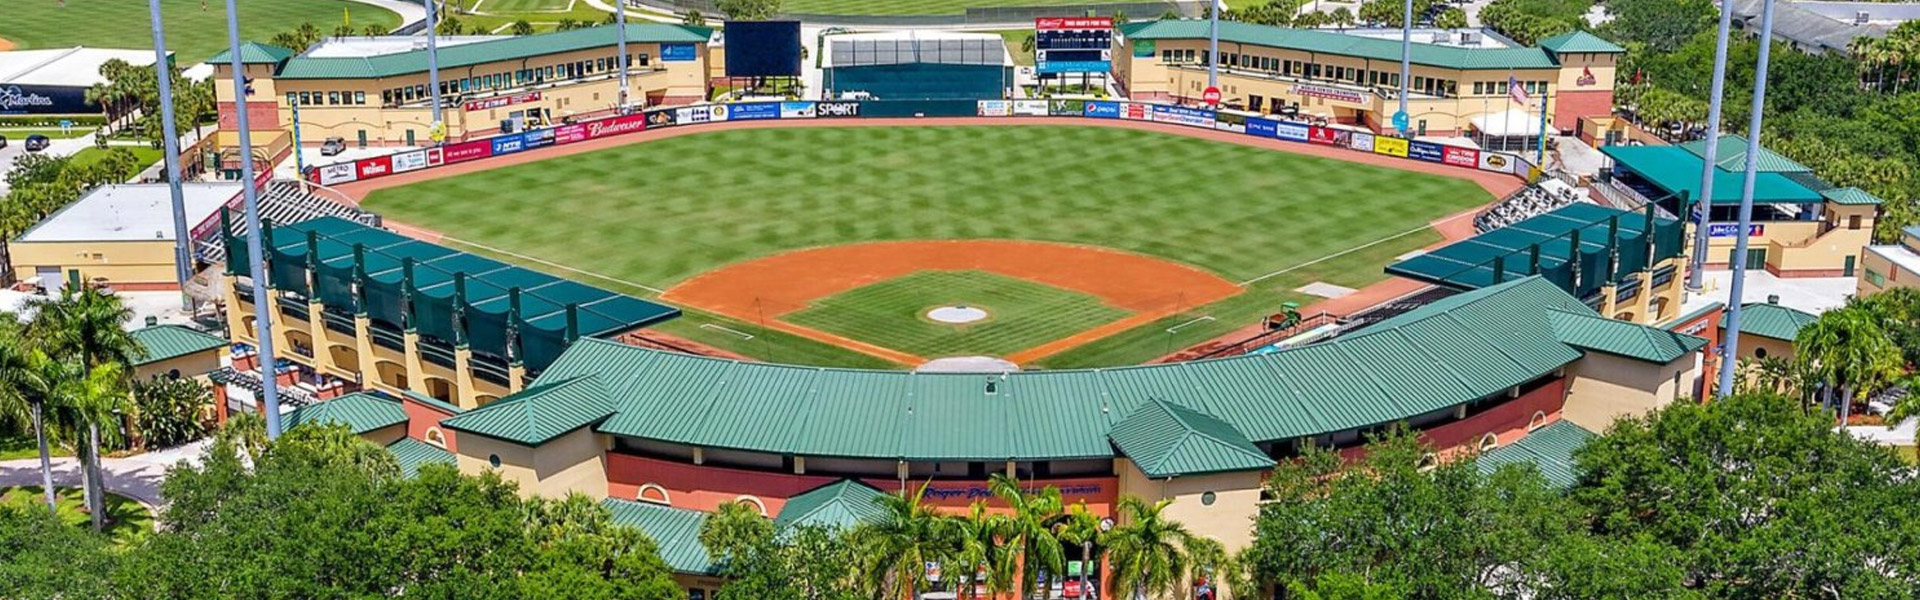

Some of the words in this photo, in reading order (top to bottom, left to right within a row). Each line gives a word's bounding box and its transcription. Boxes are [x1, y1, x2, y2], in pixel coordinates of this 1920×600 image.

[8, 93, 53, 106] Marlins
[818, 102, 859, 116] SPORT
[587, 120, 642, 137] Budweiser
[327, 165, 350, 173] METRO
[923, 487, 966, 499] Roger
